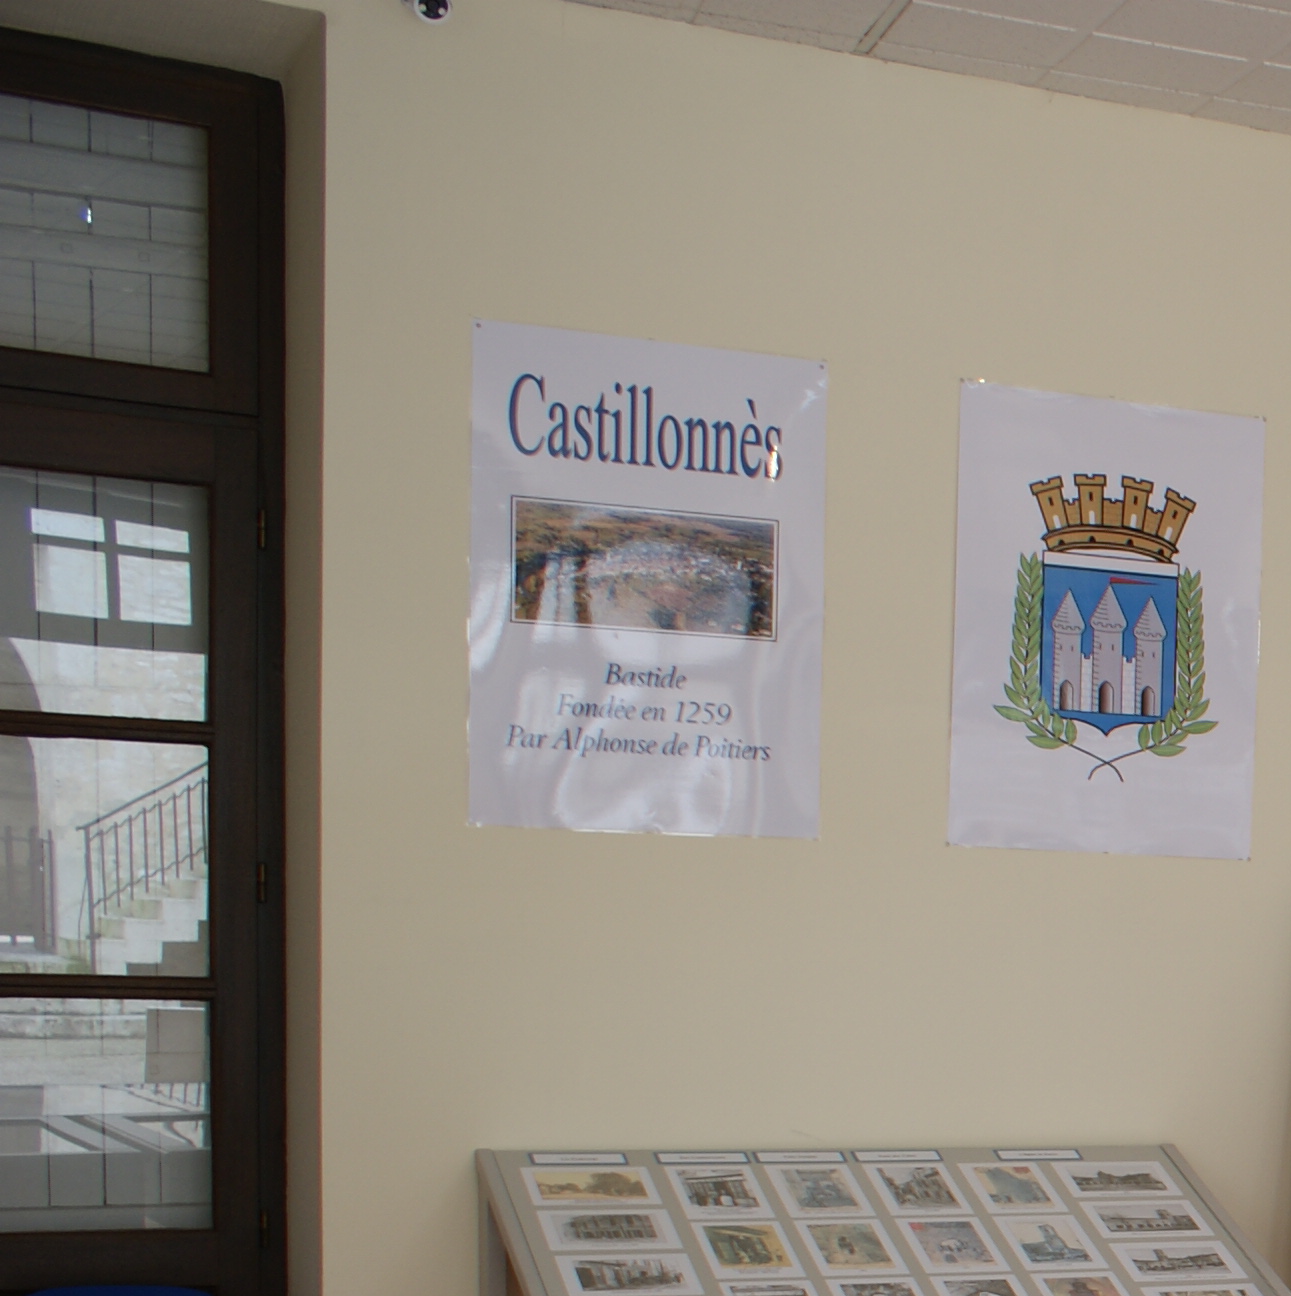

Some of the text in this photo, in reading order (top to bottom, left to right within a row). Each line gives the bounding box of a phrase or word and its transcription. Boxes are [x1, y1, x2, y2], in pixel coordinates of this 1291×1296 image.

[507, 373, 784, 482] Castillonnès
[604, 663, 688, 691] Bastide
[557, 692, 734, 727] Fondée en 1259
[506, 725, 772, 762] Par Alphonse de Poitiers
